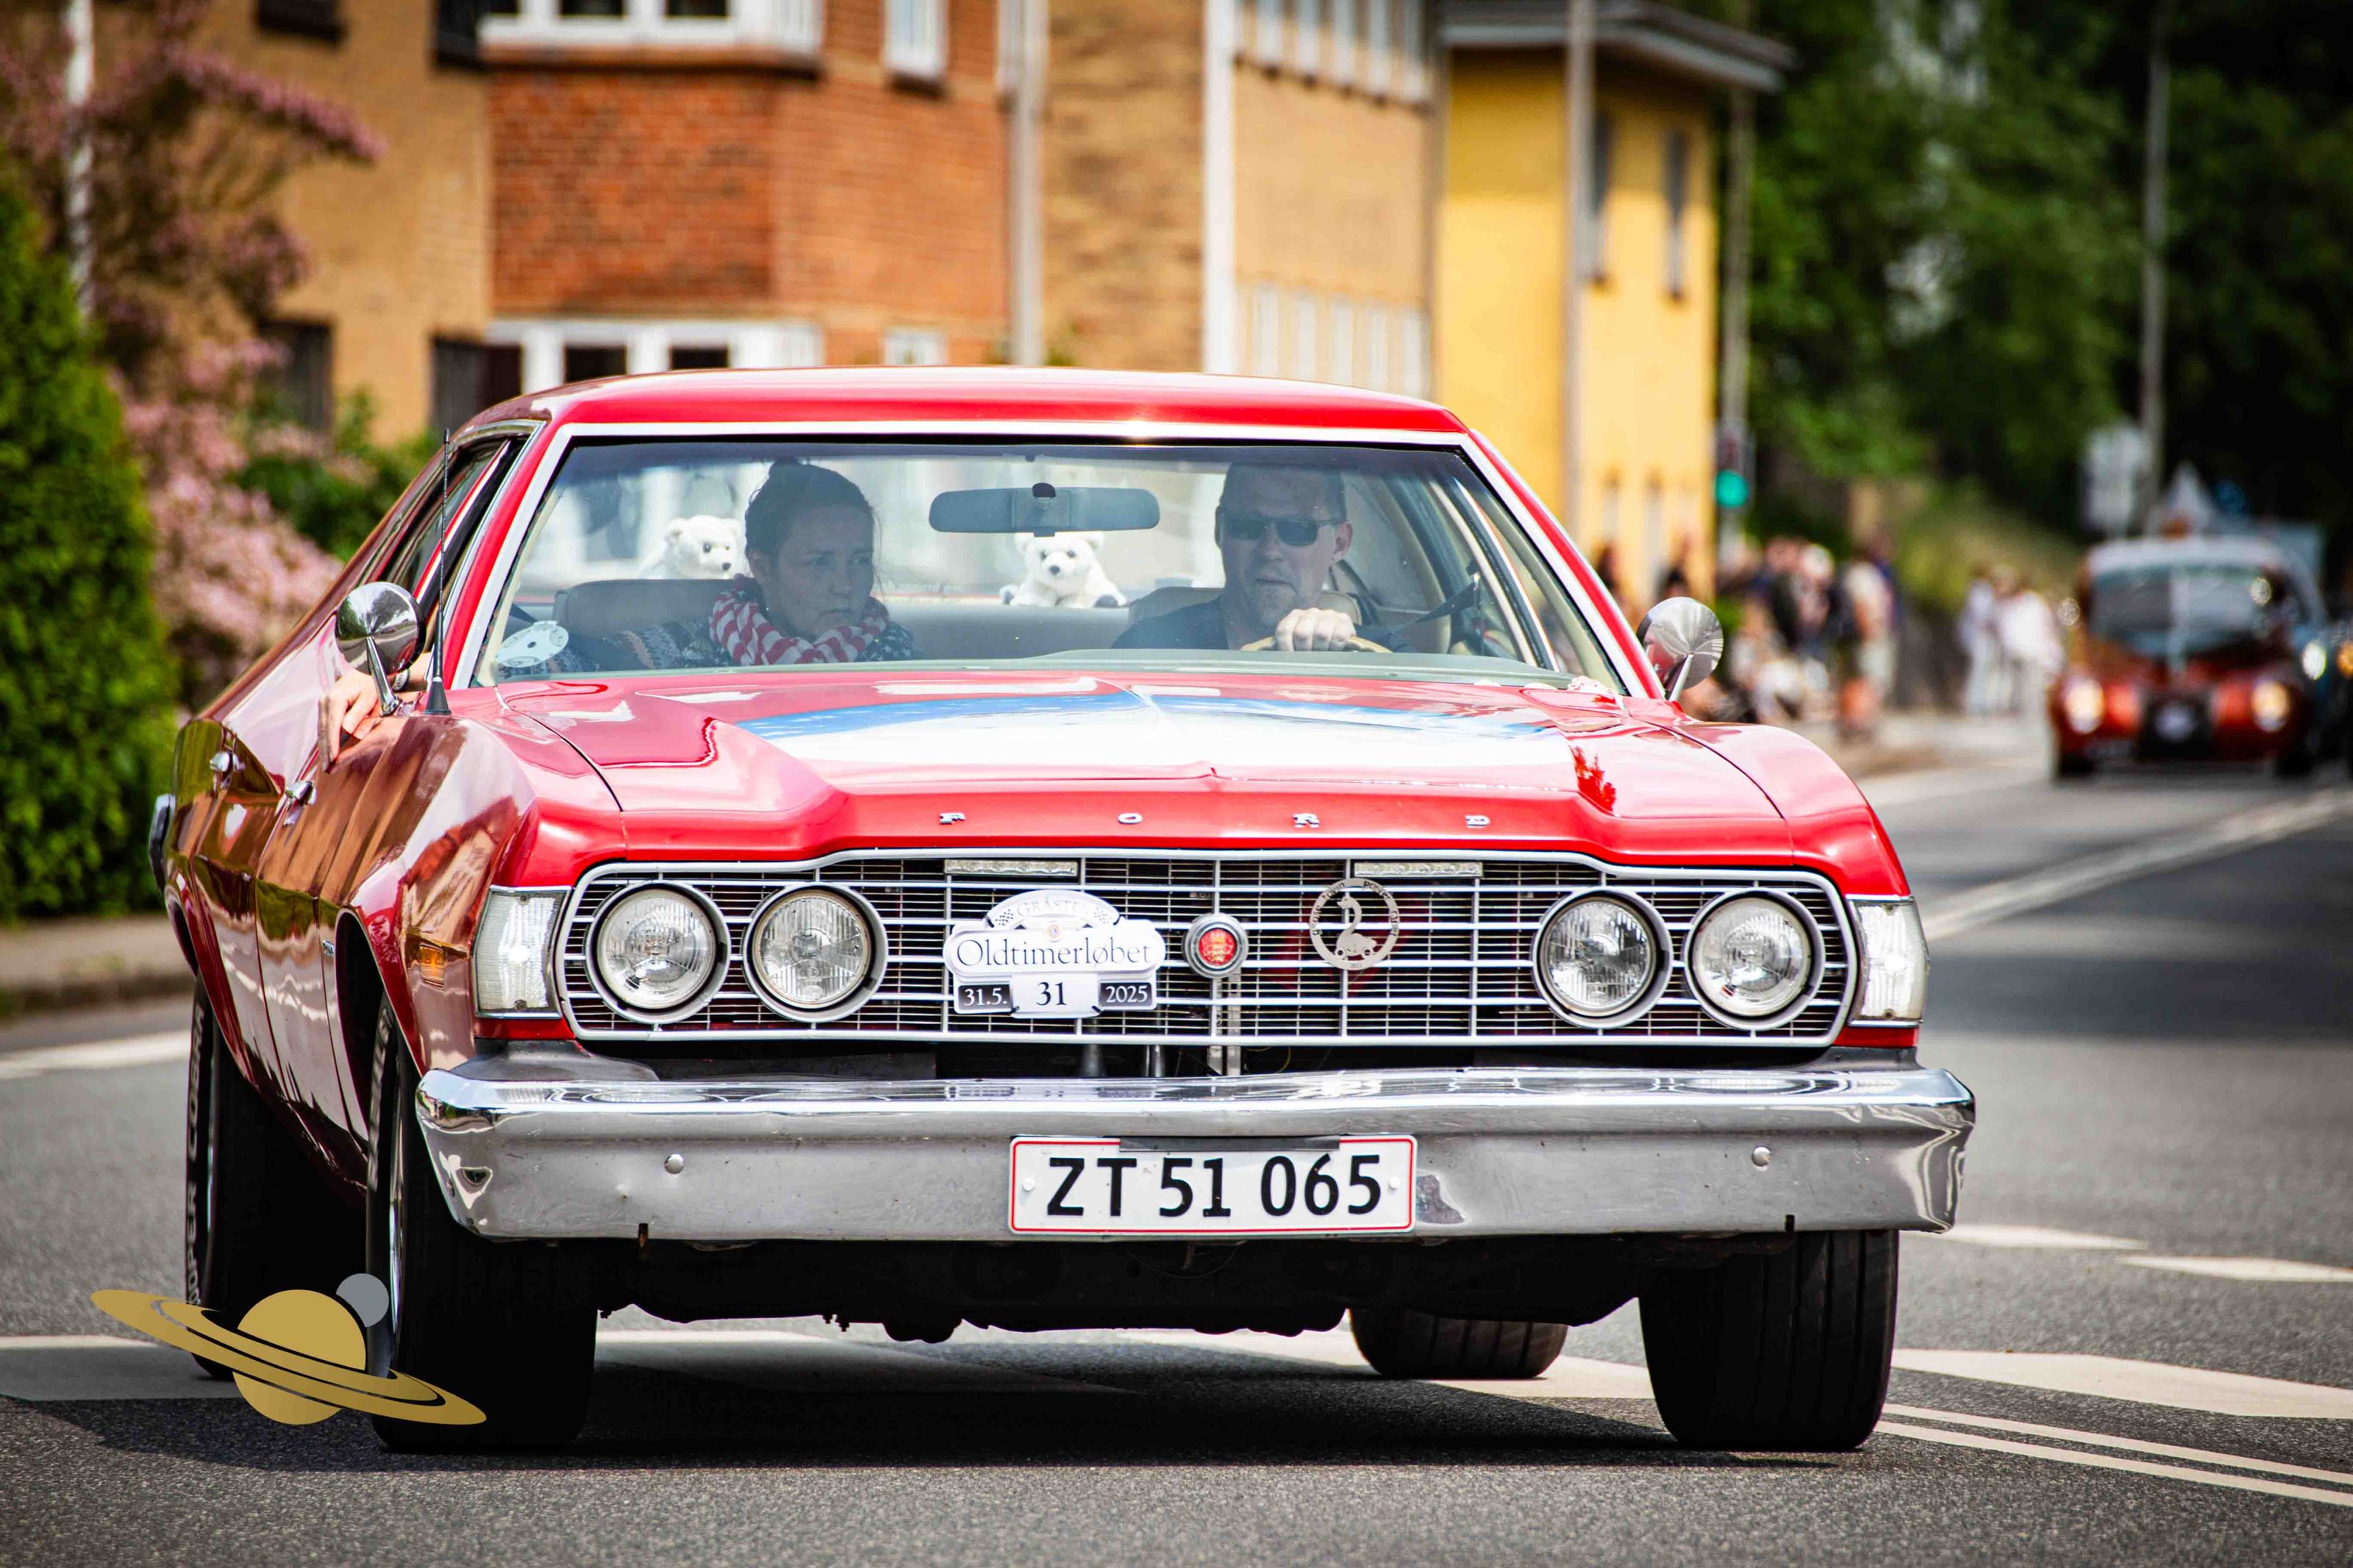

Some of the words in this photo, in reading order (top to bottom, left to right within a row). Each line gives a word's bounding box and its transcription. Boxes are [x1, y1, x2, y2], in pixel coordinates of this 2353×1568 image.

[940, 812, 1490, 828] FORD
[957, 937, 1152, 968] Oldtimerløbet
[964, 987, 1007, 1006] 31.5.
[1036, 981, 1066, 1006] 31
[1106, 985, 1148, 1003] 2025
[188, 1004, 204, 1161] COBRA
[1047, 1157, 1137, 1217] ZT
[1160, 1157, 1231, 1217] 51
[1261, 1153, 1381, 1217] 065
[188, 1181, 201, 1305] OOPER
